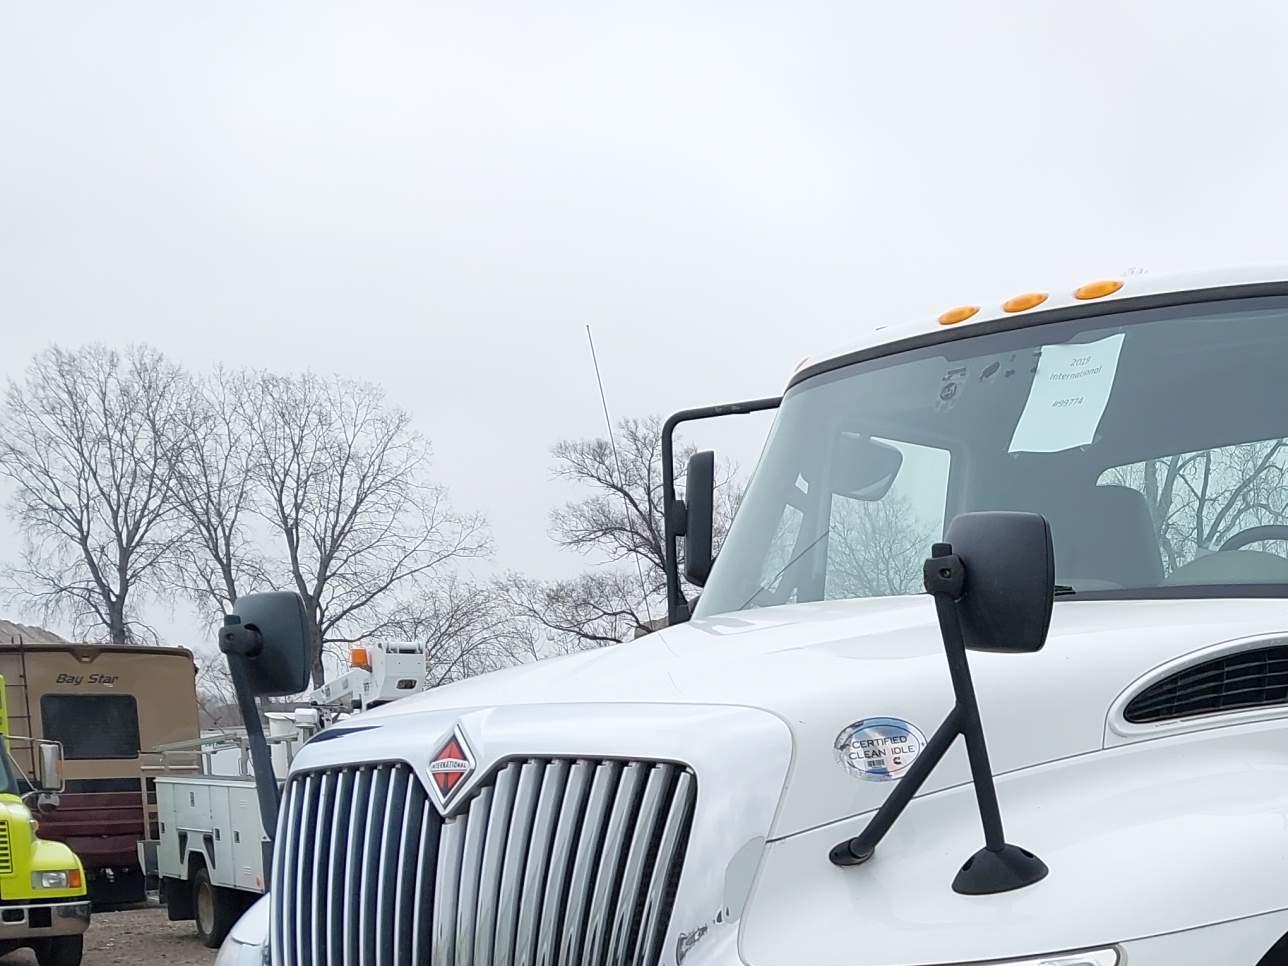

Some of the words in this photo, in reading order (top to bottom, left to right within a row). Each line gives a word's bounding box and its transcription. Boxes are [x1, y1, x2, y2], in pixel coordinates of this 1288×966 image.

[1050, 366, 1102, 380] International
[56, 673, 84, 686] Bay
[87, 673, 119, 684] Star
[852, 735, 907, 749] CERTIFIED
[848, 749, 887, 760] CLEAN
[891, 745, 916, 755] IDLE
